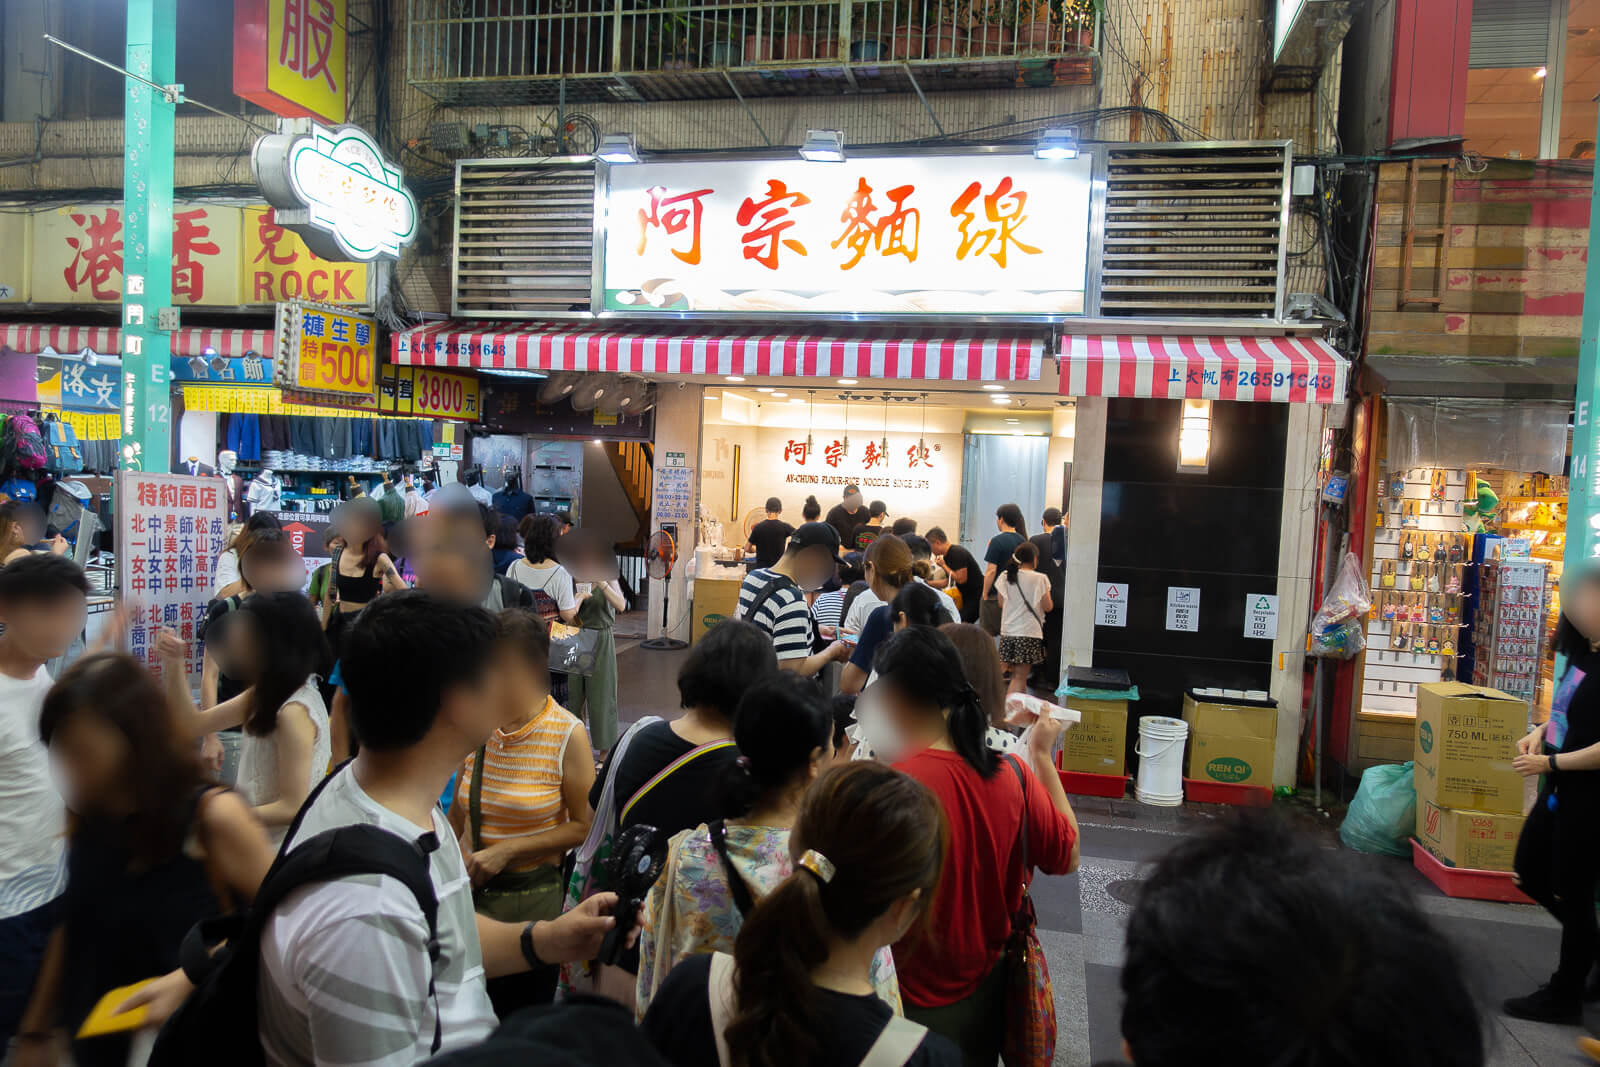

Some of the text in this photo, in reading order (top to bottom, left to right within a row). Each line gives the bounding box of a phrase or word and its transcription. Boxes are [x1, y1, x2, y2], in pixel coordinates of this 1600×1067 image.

[637, 177, 1043, 271] 阿宗麵線
[255, 270, 356, 302] ROCK
[126, 275, 144, 355] 西門町
[151, 364, 165, 384] E
[320, 343, 371, 388] 500
[417, 373, 464, 413] 3800
[465, 394, 476, 412] 元
[149, 404, 169, 423] 12
[1578, 401, 1589, 426] E
[1573, 454, 1588, 479] 14
[138, 482, 217, 510] 特約商店
[131, 513, 146, 596] 北一女中
[148, 514, 162, 595] 中山女中
[164, 514, 178, 594] 景美女中
[179, 516, 193, 594] 師大附中
[195, 516, 208, 593] 松山高中
[1446, 730, 1468, 740] 750
[1471, 732, 1488, 742] ML
[1208, 763, 1232, 773] REN
